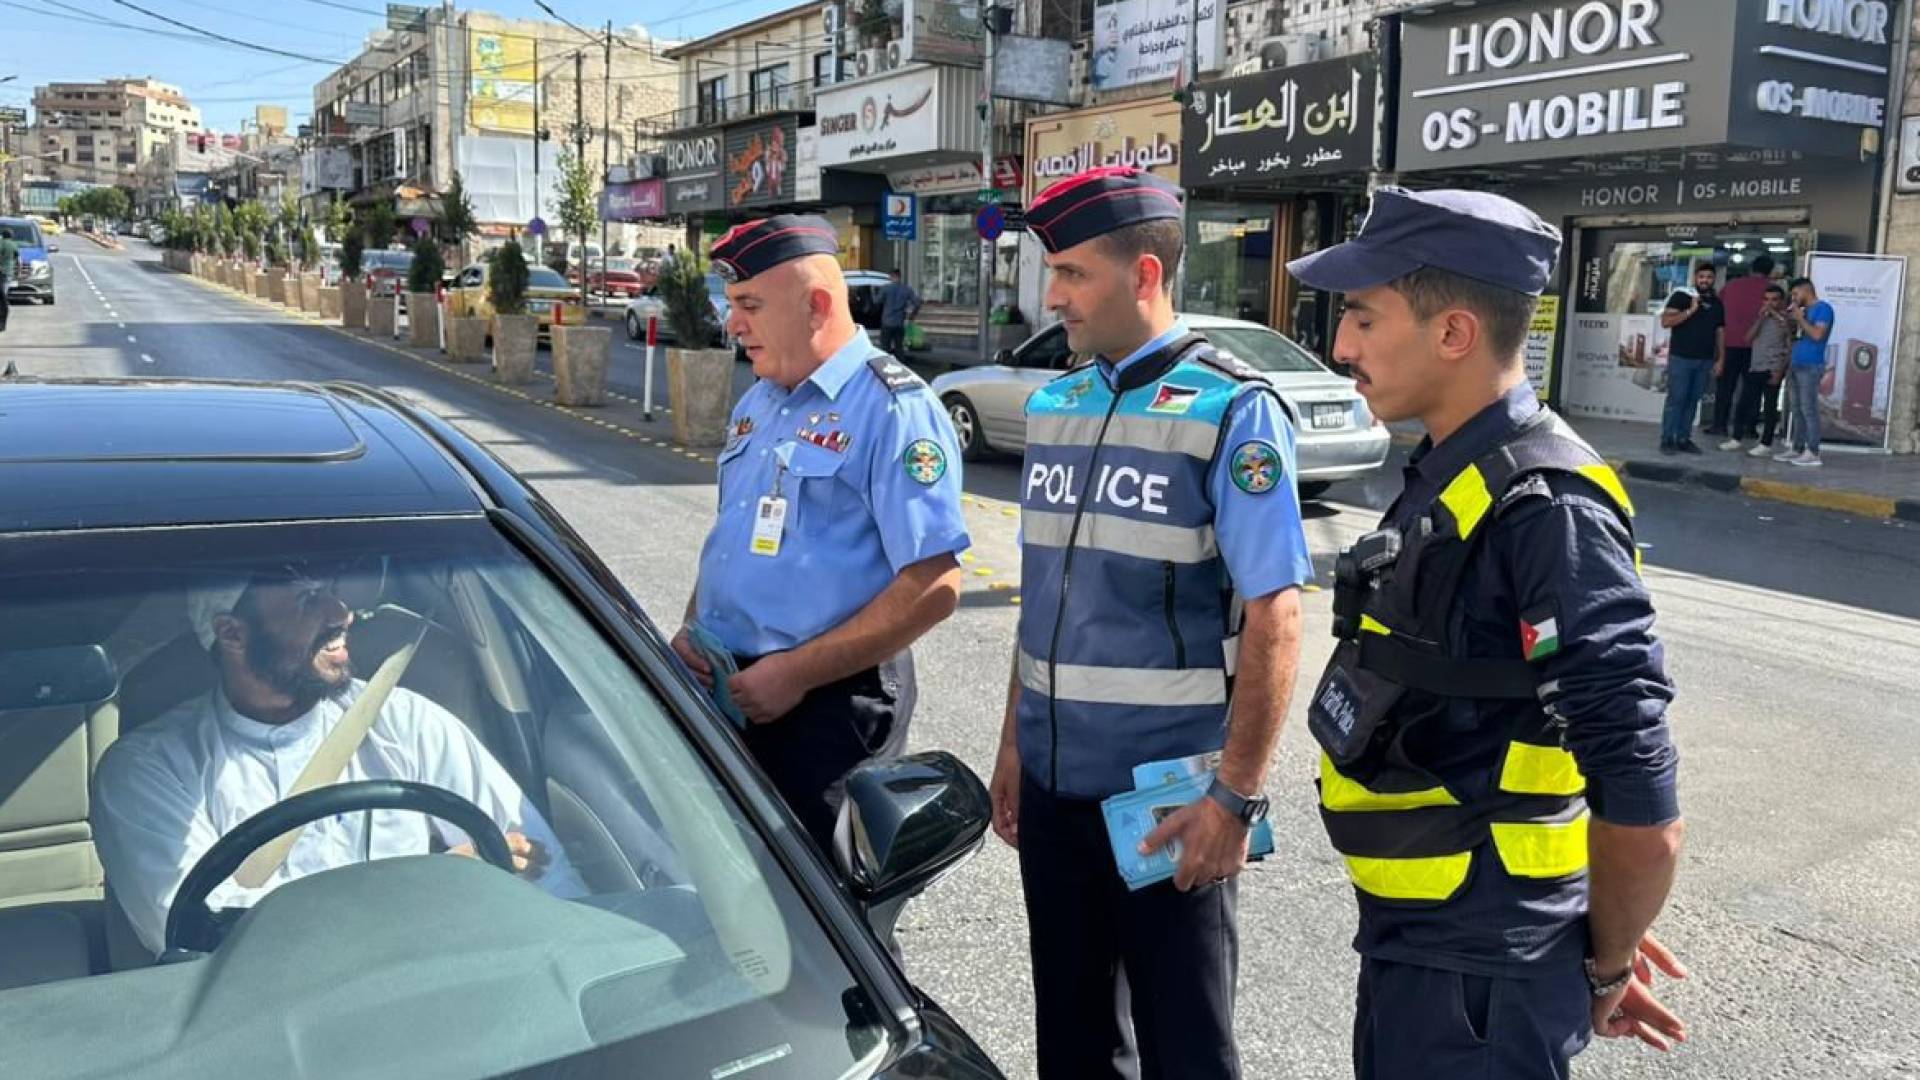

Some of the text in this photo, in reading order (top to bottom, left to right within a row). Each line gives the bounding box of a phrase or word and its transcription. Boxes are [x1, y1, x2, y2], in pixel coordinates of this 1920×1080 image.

[1447, 0, 1660, 75] HONOR
[1767, 0, 1888, 44] HONOR
[820, 112, 857, 137] SINGER
[1198, 67, 1362, 155] ابن العطار
[1504, 81, 1686, 144] MOBILE
[666, 136, 717, 171] HONOR
[1207, 146, 1344, 177] عطور بخور مباخر
[1581, 184, 1660, 207] HONOR
[1730, 178, 1802, 198] MOBILE
[1578, 319, 1609, 329] TECNO
[1025, 463, 1171, 515] POLICE
